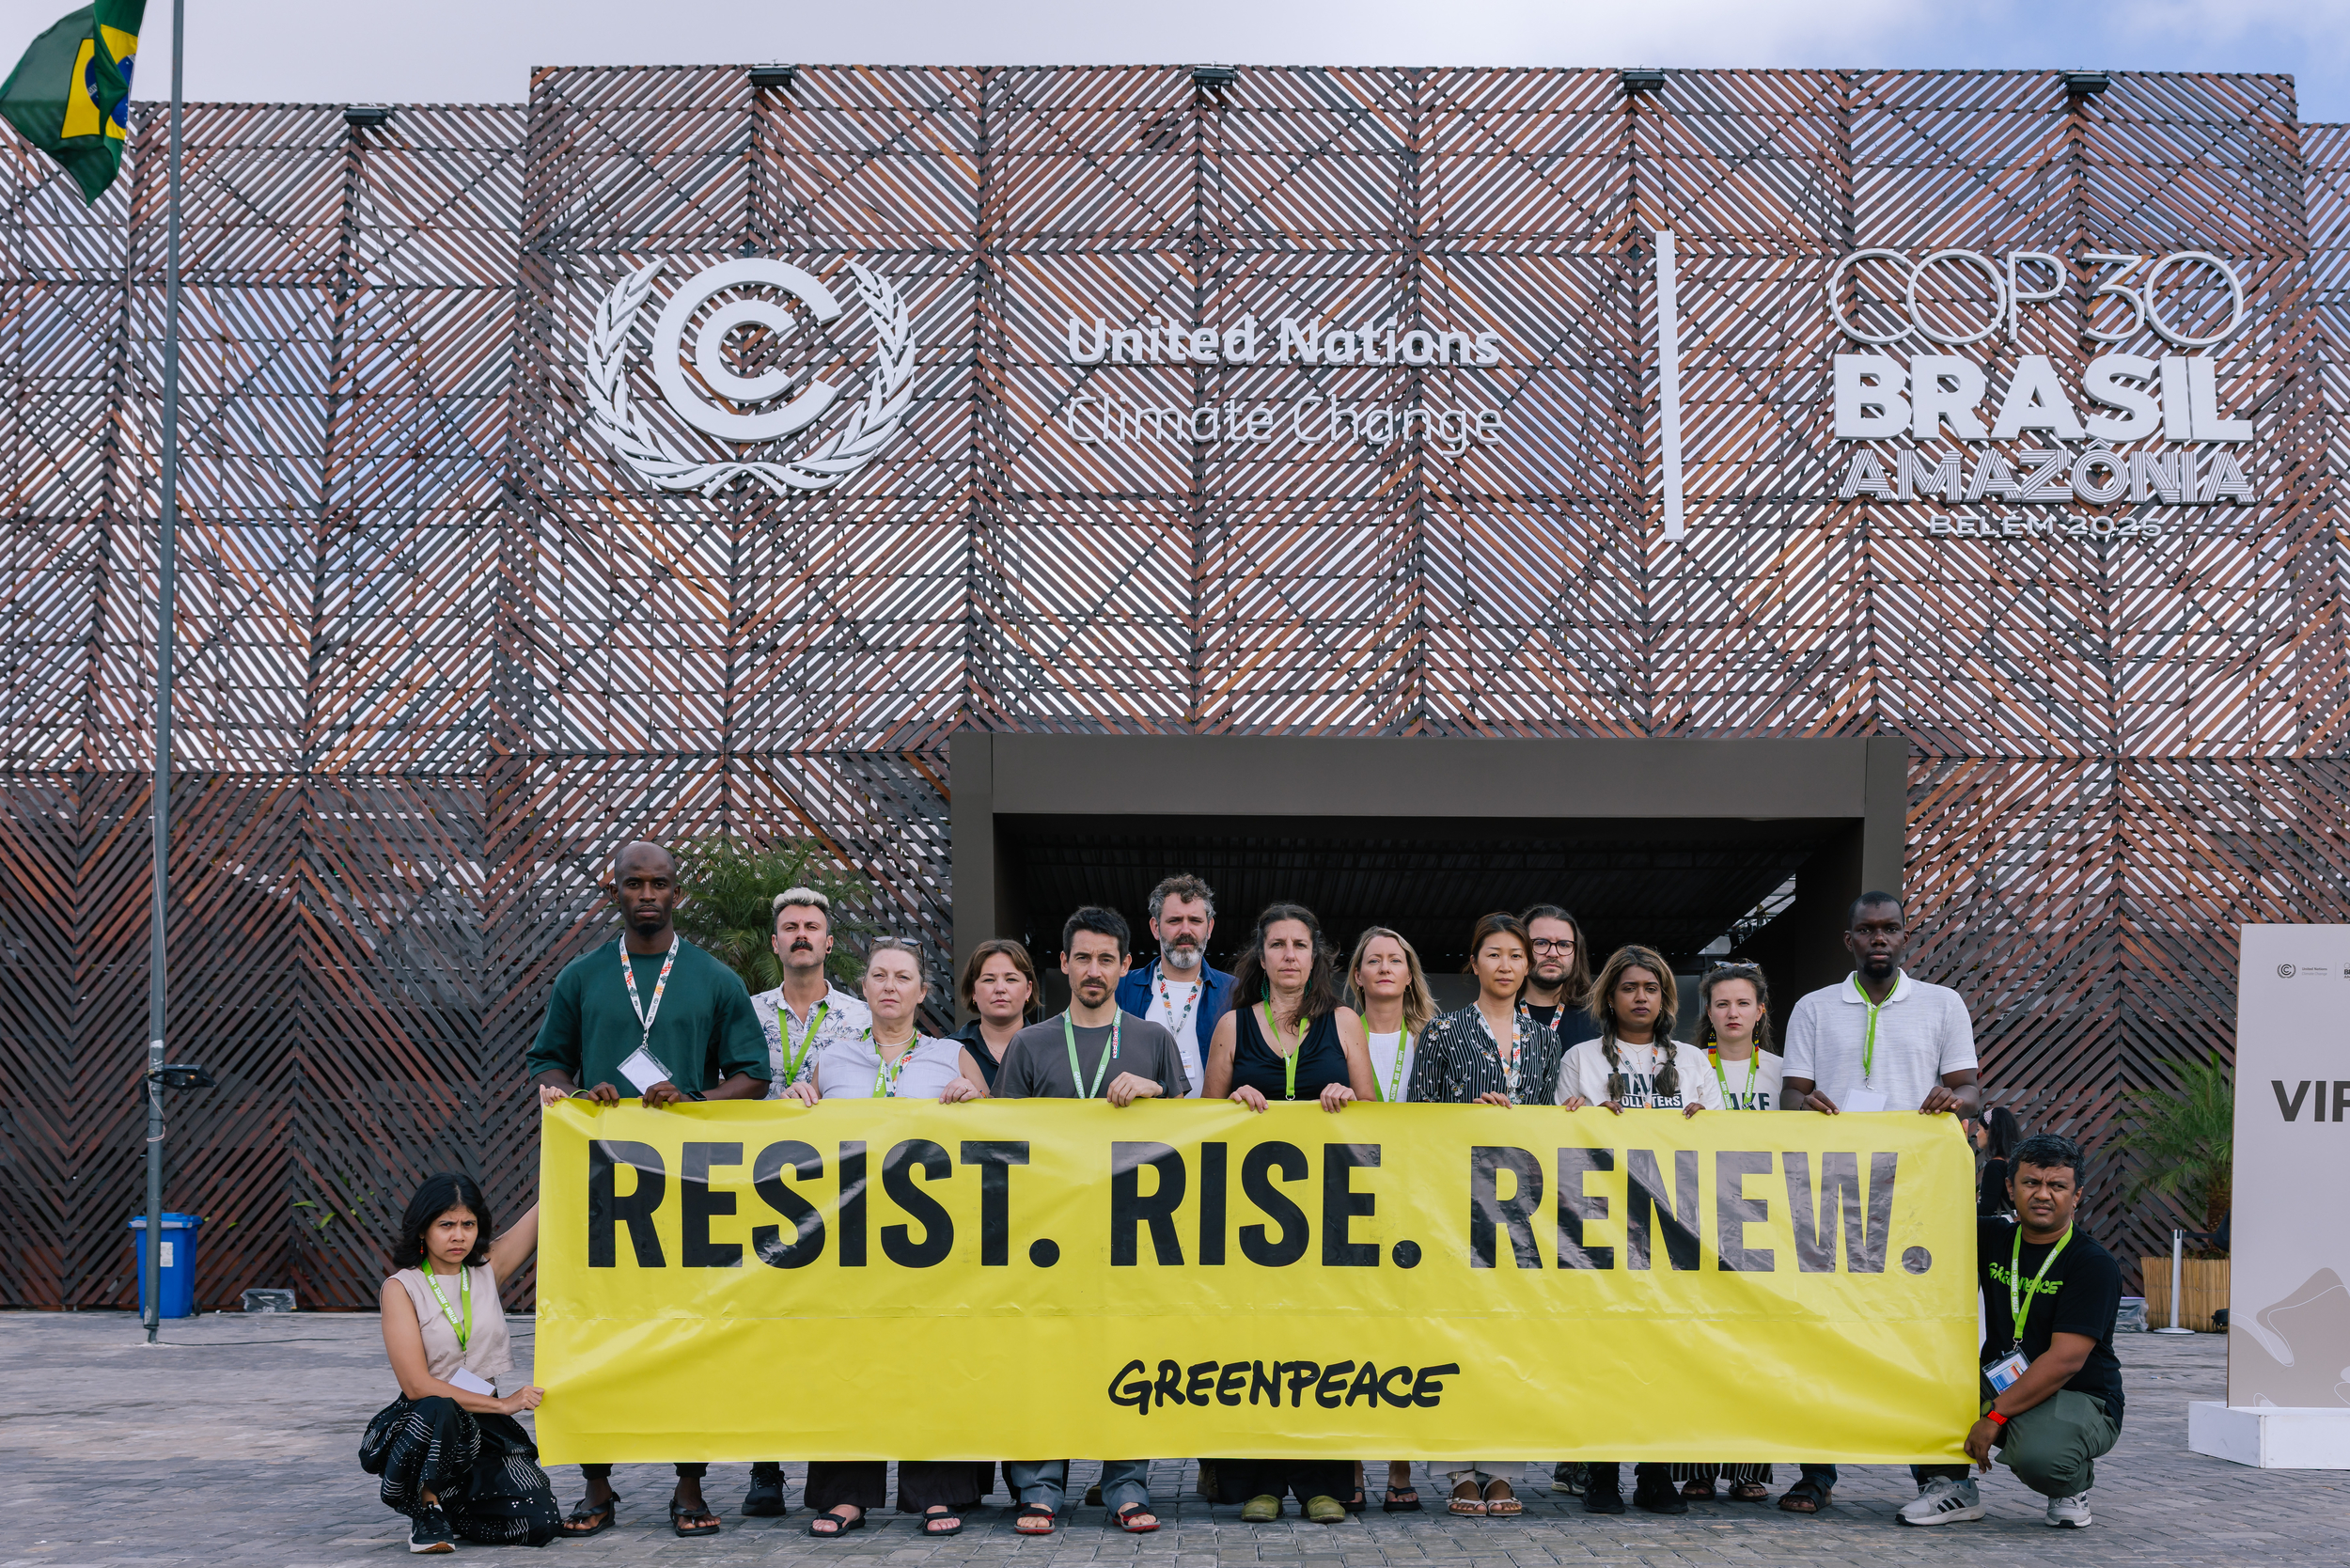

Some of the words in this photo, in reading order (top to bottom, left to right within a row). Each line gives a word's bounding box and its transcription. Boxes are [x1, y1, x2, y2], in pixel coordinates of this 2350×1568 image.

[1067, 314, 1256, 367] United
[1278, 315, 1501, 368] Nations
[1066, 393, 1274, 446] Climate
[1292, 393, 1503, 459] Change
[1832, 353, 2254, 445] BRASIL
[1838, 437, 2256, 507] AMAZÔNIA
[1929, 510, 2055, 539] BELÉM
[2065, 515, 2163, 539] 2025
[1621, 1095, 1681, 1108] OLLTERS
[588, 1137, 1060, 1269] RESIST.
[1110, 1140, 1422, 1269] RISE.
[1470, 1145, 1933, 1276] RENEW.
[428, 1274, 436, 1286] HOPE
[434, 1286, 448, 1305] JUSTICE
[445, 1306, 459, 1325] ACTION
[1107, 1358, 1461, 1416] GREENPEACE
